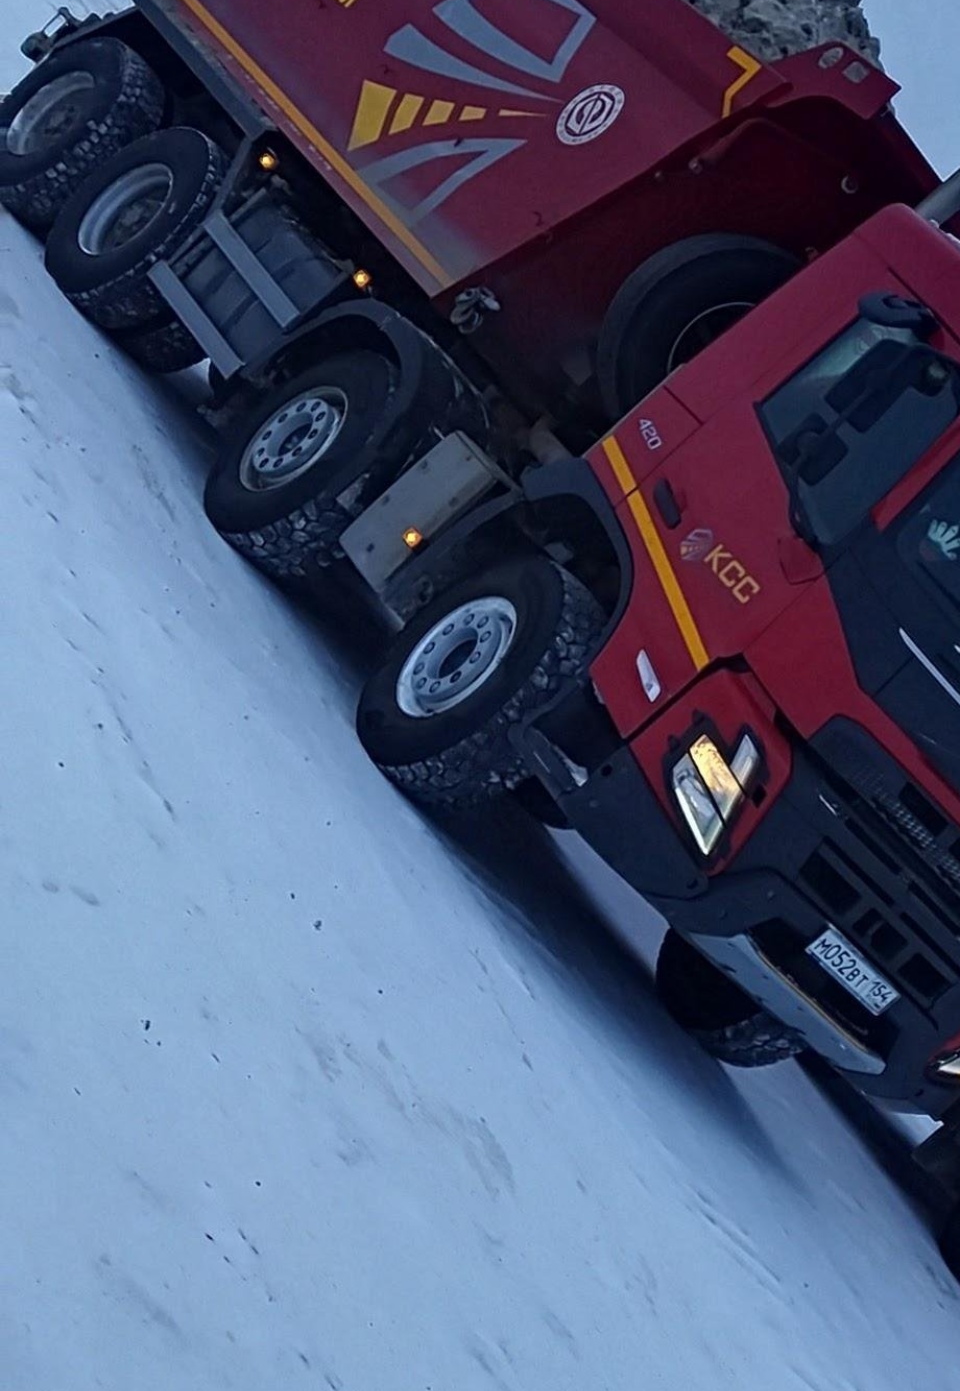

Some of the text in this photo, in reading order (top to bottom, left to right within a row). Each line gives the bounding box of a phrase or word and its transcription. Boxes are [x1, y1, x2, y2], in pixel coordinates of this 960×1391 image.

[639, 417, 663, 450] 420
[704, 543, 761, 604] КСС
[869, 980, 892, 1003] 154
